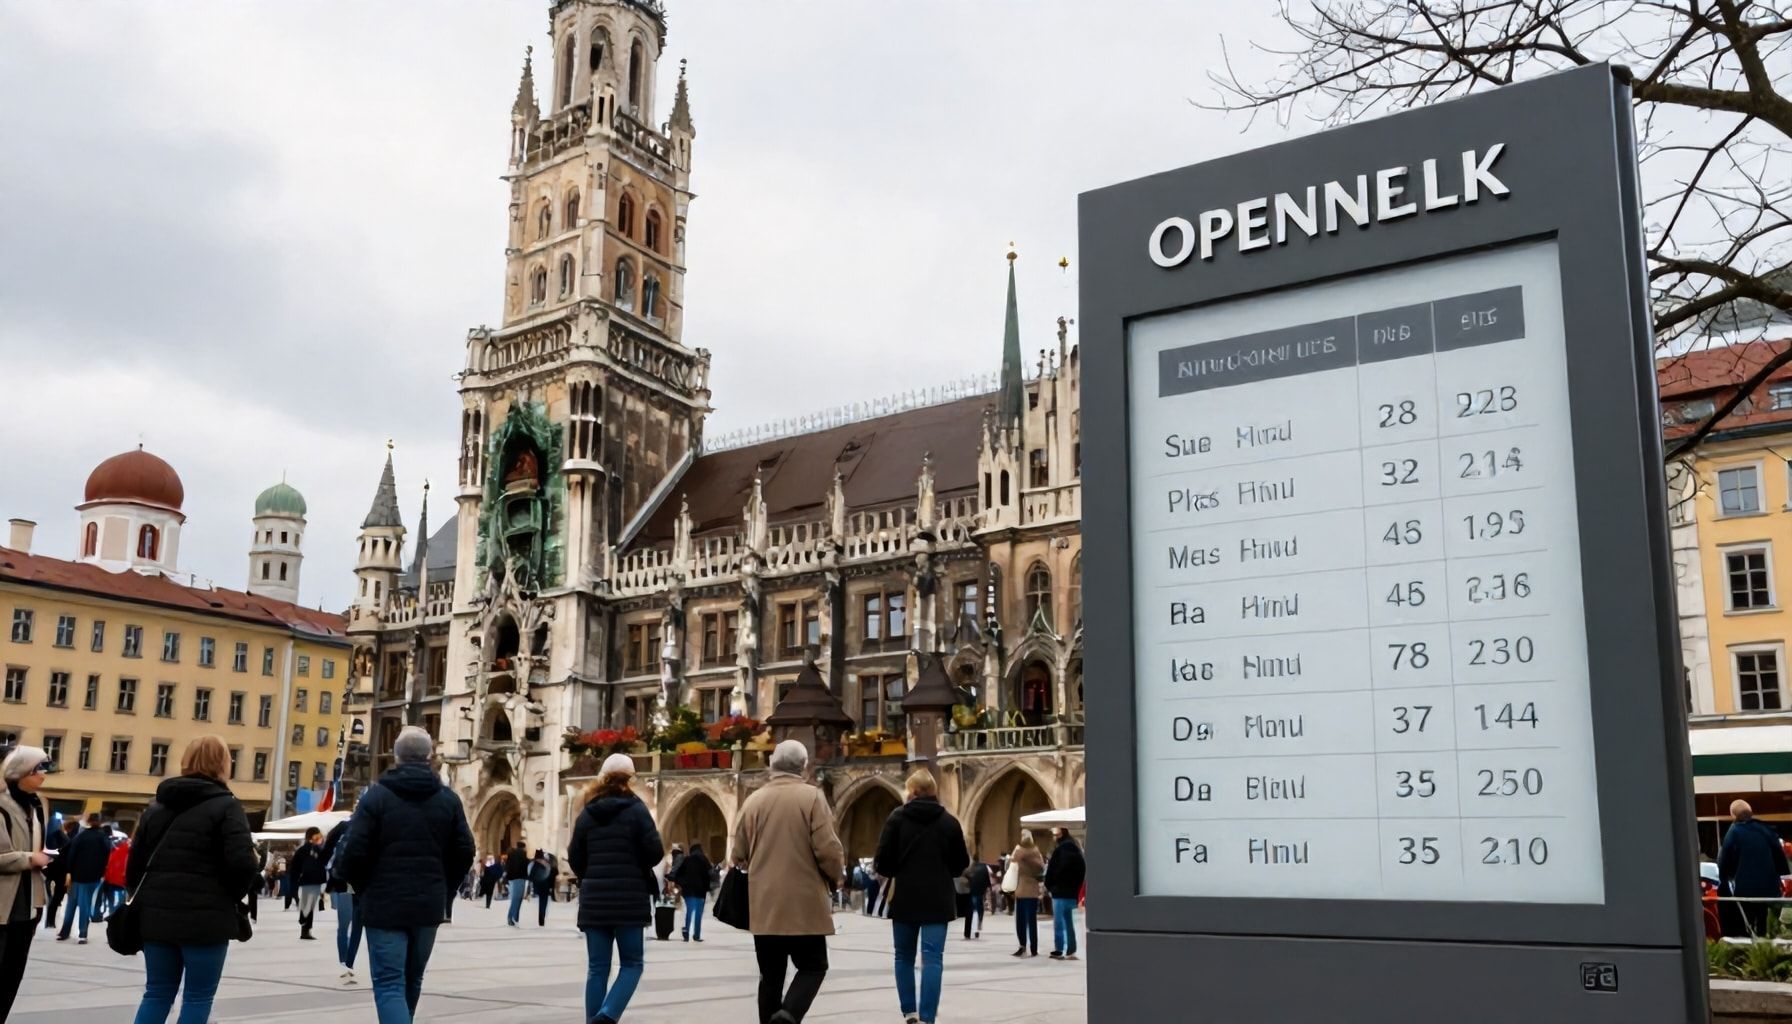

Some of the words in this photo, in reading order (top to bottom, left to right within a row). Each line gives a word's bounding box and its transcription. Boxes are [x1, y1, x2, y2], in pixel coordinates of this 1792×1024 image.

[1148, 142, 1511, 268] OPENNELK
[1378, 400, 1418, 429] 28
[1381, 458, 1420, 487] 32
[1388, 641, 1430, 671] 78
[1468, 635, 1534, 666] 230
[1392, 705, 1433, 734] 37
[1474, 701, 1539, 731] 144
[1395, 769, 1437, 798] 35
[1398, 836, 1441, 865] 35
